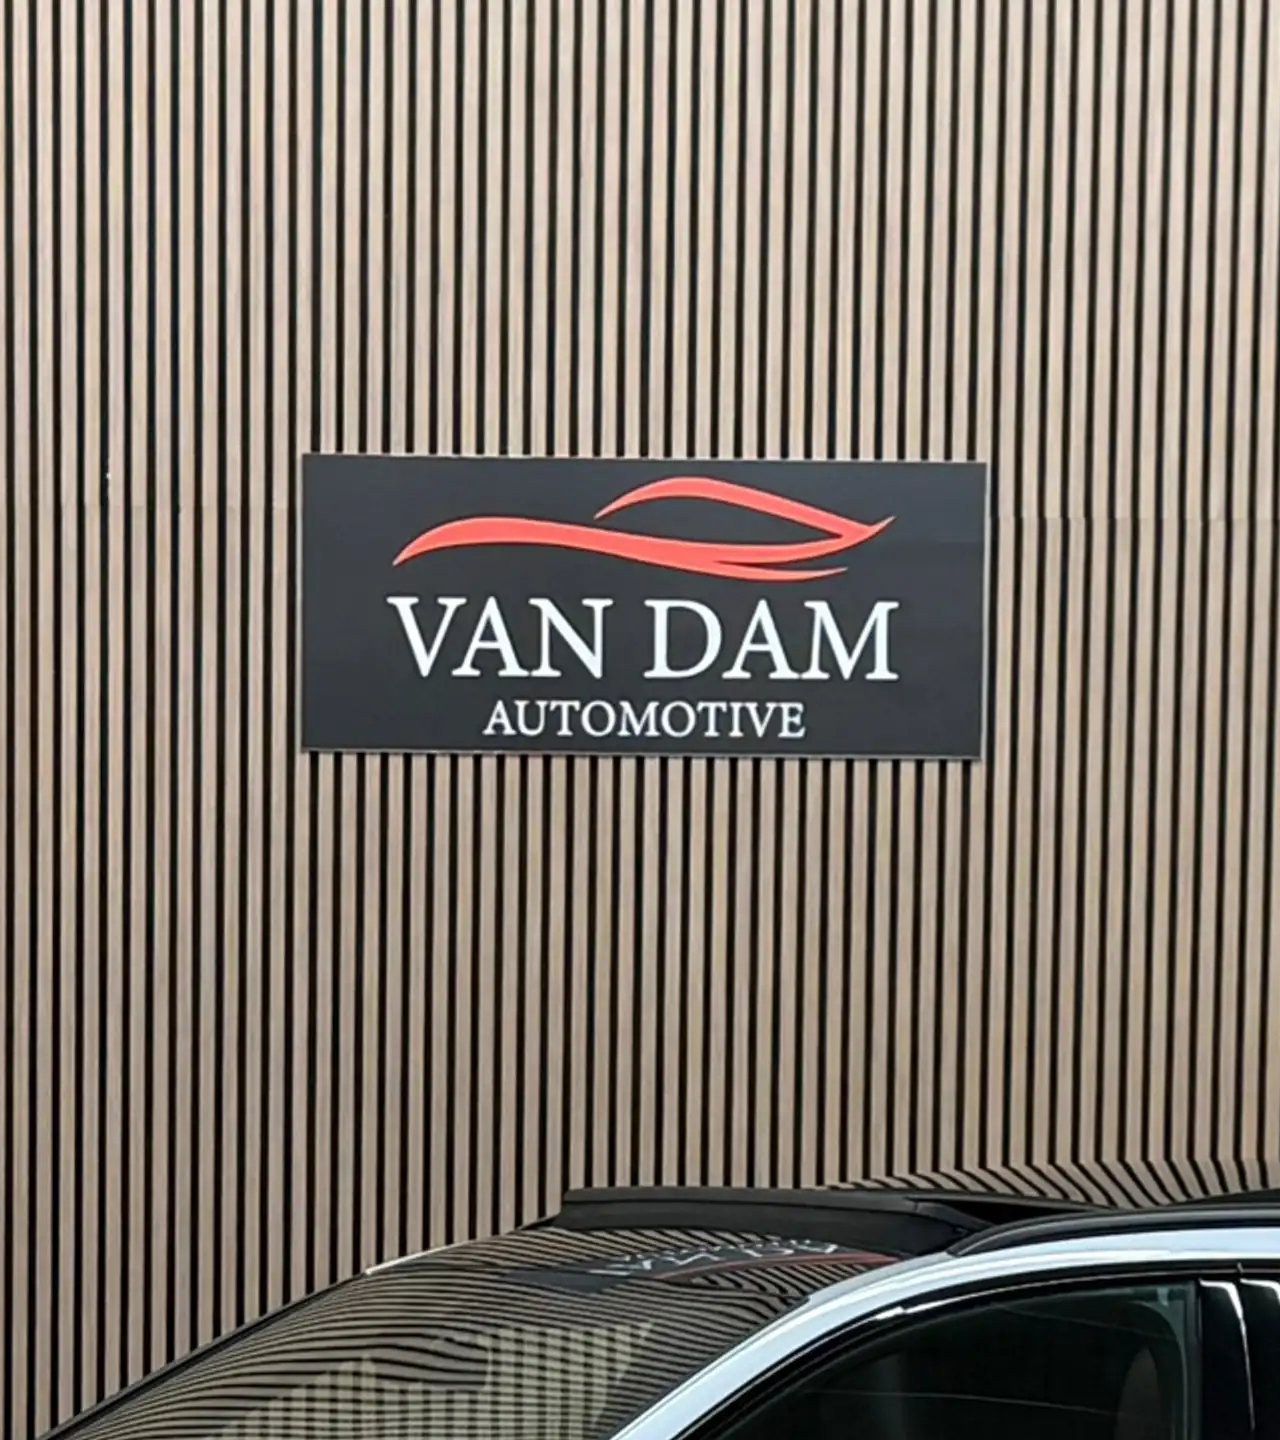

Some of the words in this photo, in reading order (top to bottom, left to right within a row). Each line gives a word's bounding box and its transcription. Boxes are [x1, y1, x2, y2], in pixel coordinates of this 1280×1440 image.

[386, 596, 614, 679] VAN
[643, 599, 900, 681] DAM
[482, 699, 806, 739] AUTOMOTIVE
